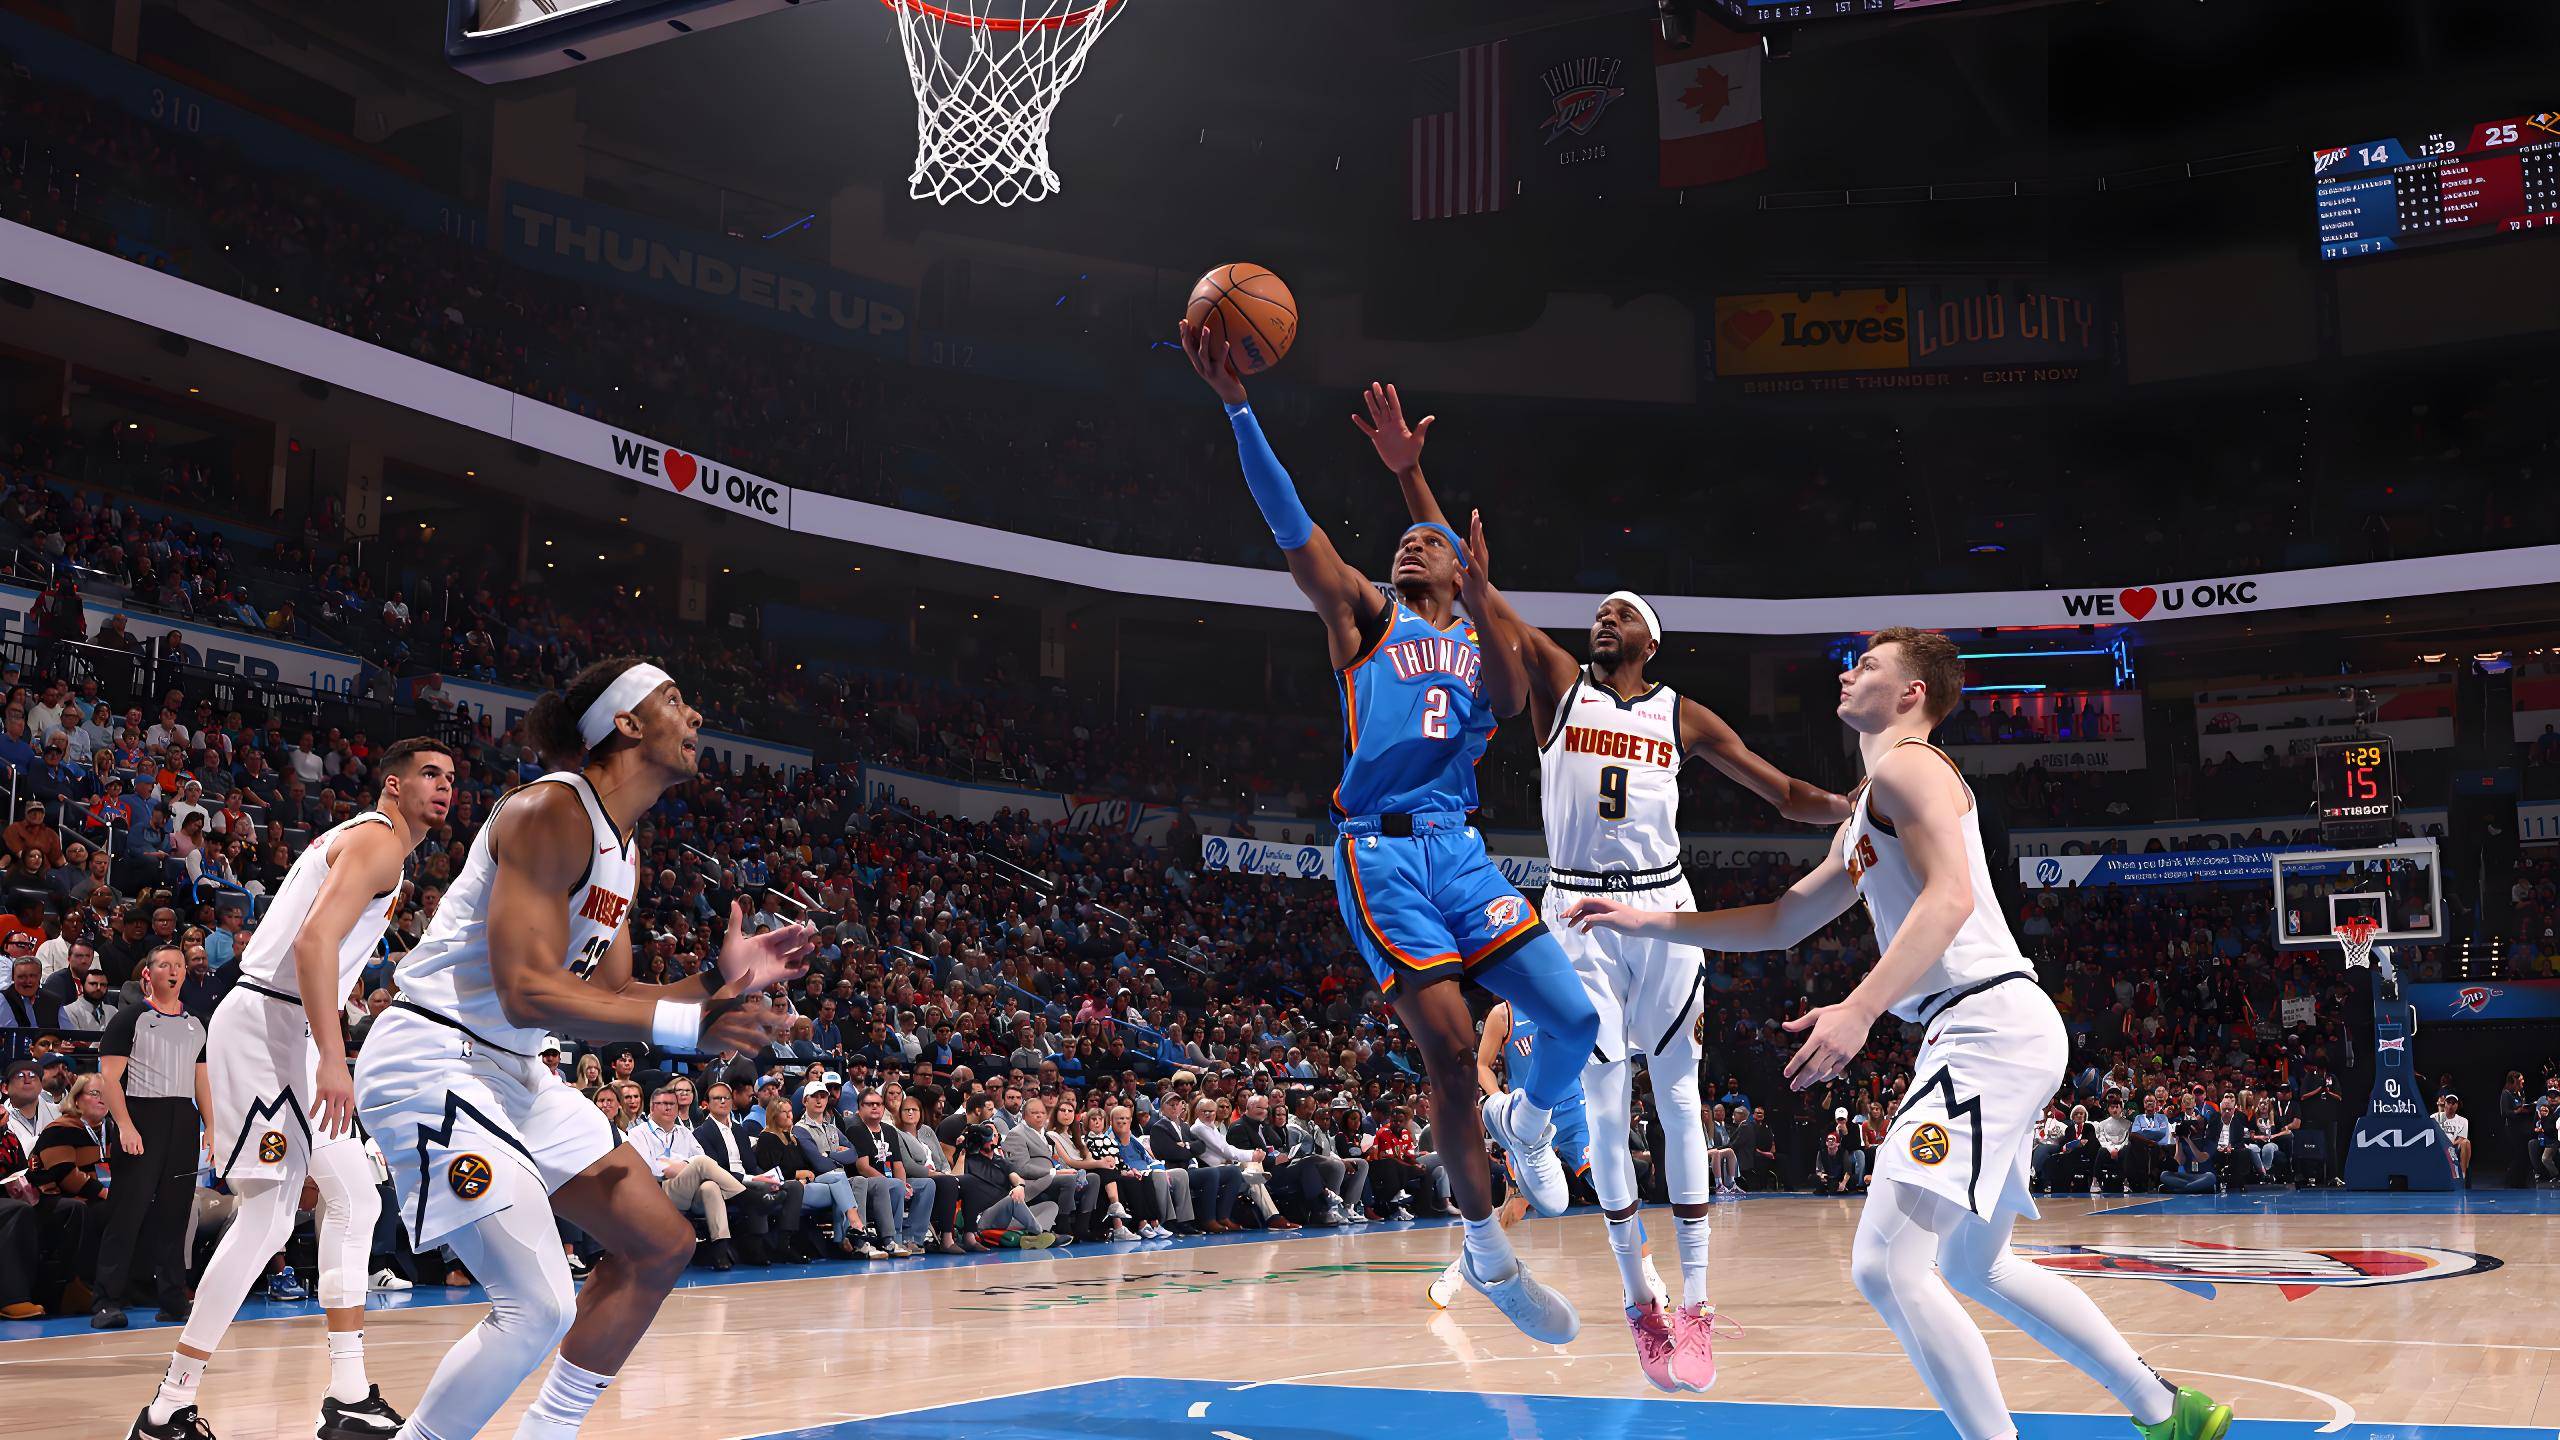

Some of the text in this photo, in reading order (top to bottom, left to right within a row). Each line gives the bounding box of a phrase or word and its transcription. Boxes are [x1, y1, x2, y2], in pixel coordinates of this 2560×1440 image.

[151, 88, 200, 133] 310
[2420, 141, 2455, 156] 1:29
[2485, 125, 2518, 146] 25
[2359, 146, 2388, 166] 14
[512, 205, 905, 336] THUNDER UP
[1918, 295, 2006, 357] LOUD
[2019, 293, 2094, 352] CITY
[1744, 378, 1805, 394] BRING
[1812, 377, 1850, 391] THE
[1855, 373, 1951, 390] THUNDER
[2033, 367, 2081, 382] NOW
[612, 435, 779, 515] WE U OKC
[2062, 581, 2259, 617] WE U OKC
[1384, 637, 1482, 694] THUNDE
[1421, 685, 1451, 740] 2
[1565, 725, 1674, 769] NUGGETS
[2345, 747, 2381, 767] 1:29
[1599, 765, 1629, 821] 9
[2346, 767, 2378, 799] 15
[2523, 815, 2560, 838] 111
[2372, 1099, 2417, 1114] Health
